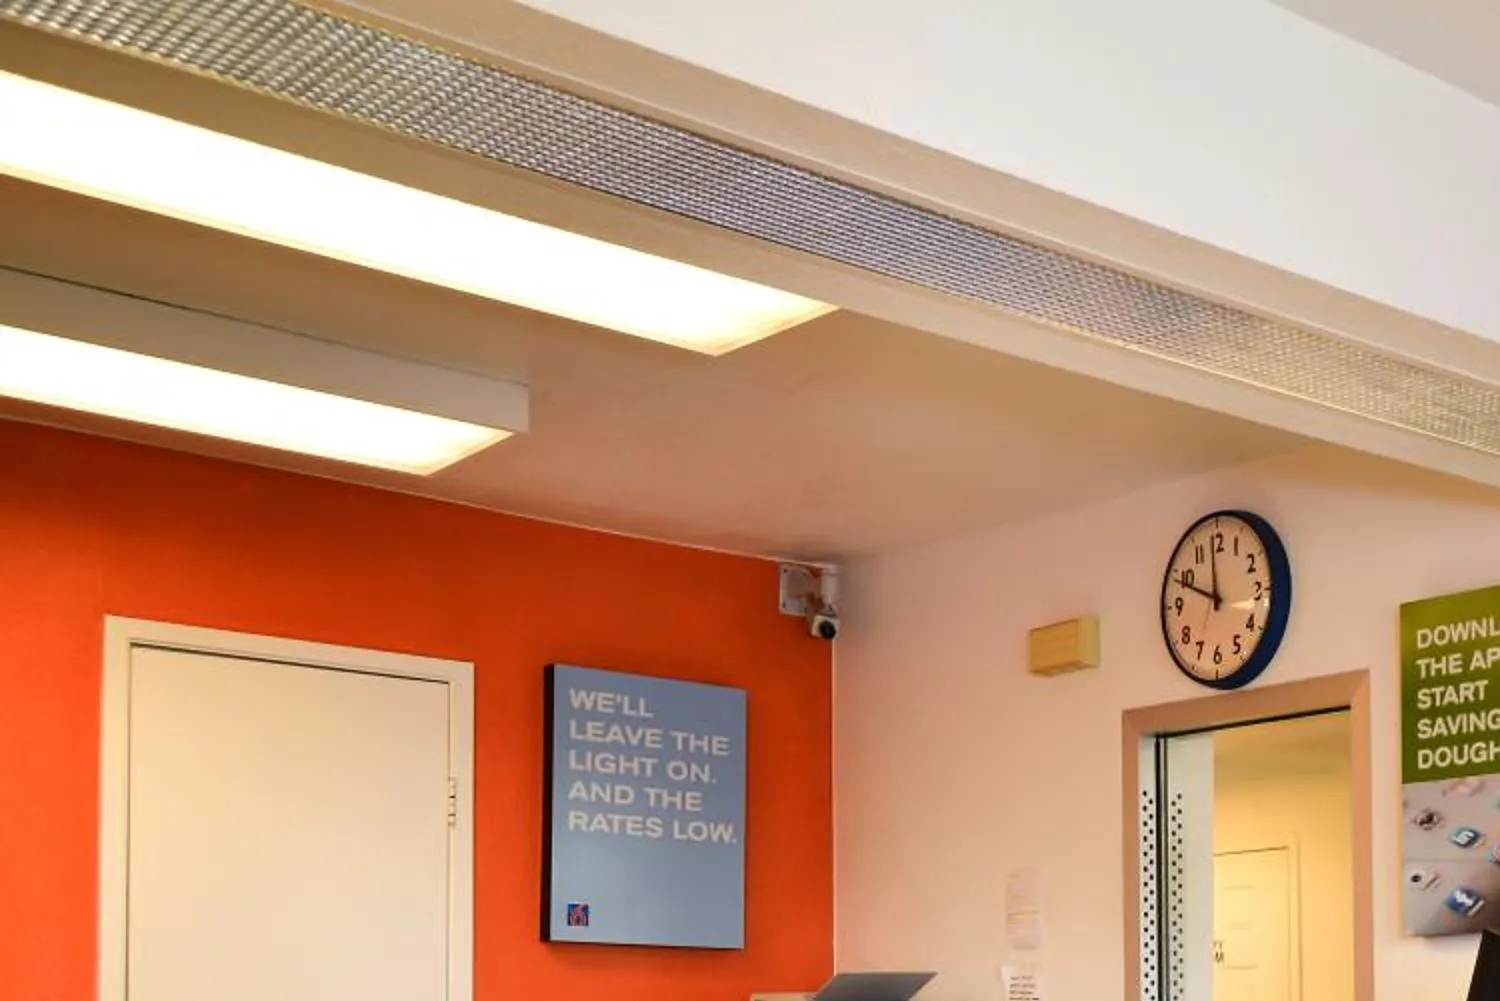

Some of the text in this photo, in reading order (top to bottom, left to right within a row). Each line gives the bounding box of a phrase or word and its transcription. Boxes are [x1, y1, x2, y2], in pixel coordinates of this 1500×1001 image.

[1195, 544, 1205, 564] 11
[1233, 536, 1239, 556] 1
[1247, 554, 1256, 573] 2
[1181, 569, 1195, 588] 10
[1254, 581, 1262, 600] 3
[1175, 597, 1184, 616] 9
[1245, 613, 1255, 632] 4
[1181, 625, 1191, 644] 8
[1232, 635, 1241, 654] 5
[1195, 640, 1204, 660] 7
[1213, 645, 1222, 664] 6
[1415, 653, 1463, 680] THE
[568, 687, 655, 718] WE'LL
[1416, 679, 1488, 710] START
[569, 719, 731, 756] LEAVE THE
[568, 749, 718, 785] LIGHT ON.
[568, 780, 703, 812] AND THE
[567, 810, 738, 845] RATES LOW.
